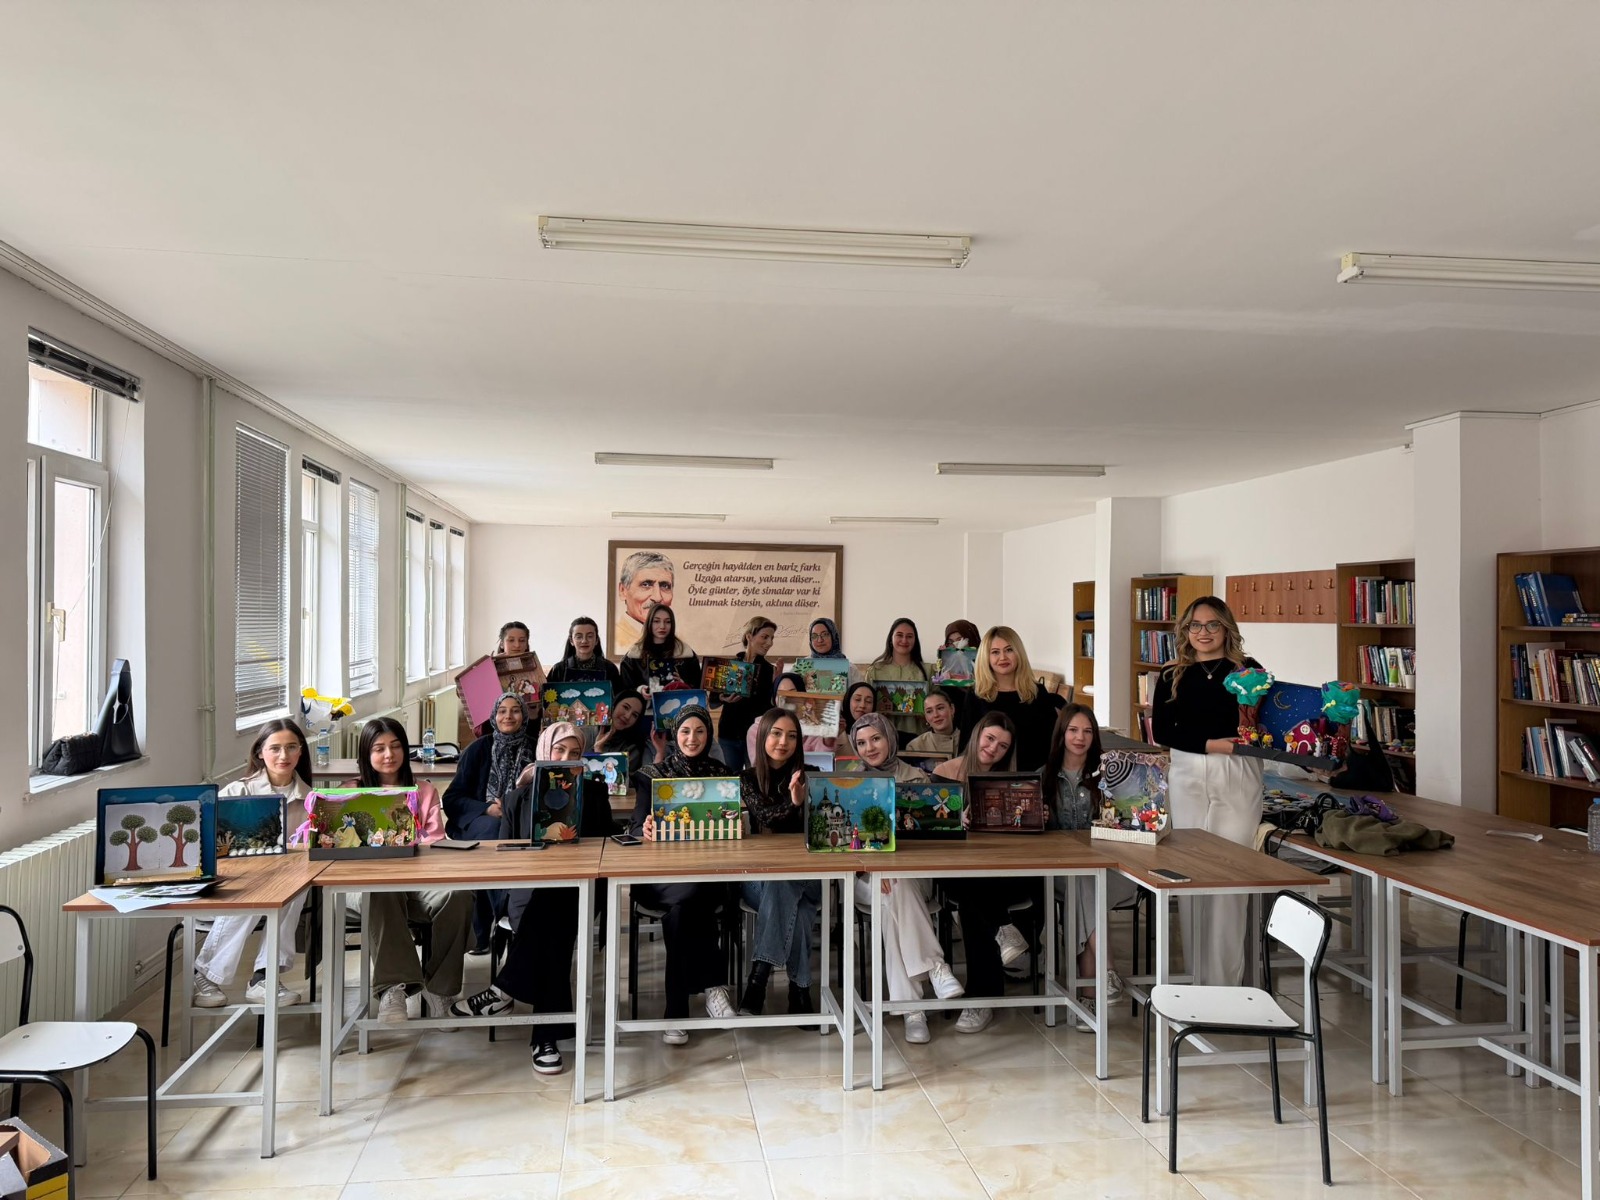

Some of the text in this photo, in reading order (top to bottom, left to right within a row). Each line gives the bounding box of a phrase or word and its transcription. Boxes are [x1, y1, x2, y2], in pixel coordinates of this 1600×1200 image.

[683, 561, 720, 572] Gerçeğin
[722, 562, 762, 572] hayâlden
[776, 562, 798, 572] bariz
[799, 562, 821, 572] farkı
[694, 574, 820, 584] Uzağa atarsın, yakına düşer...
[688, 584, 708, 596] Öyle
[708, 586, 740, 596] günler,
[742, 586, 760, 596] öyle
[762, 586, 794, 595] simalar
[812, 586, 821, 596] ki
[688, 598, 820, 608] Unutmak istersin, aklına düşer.
